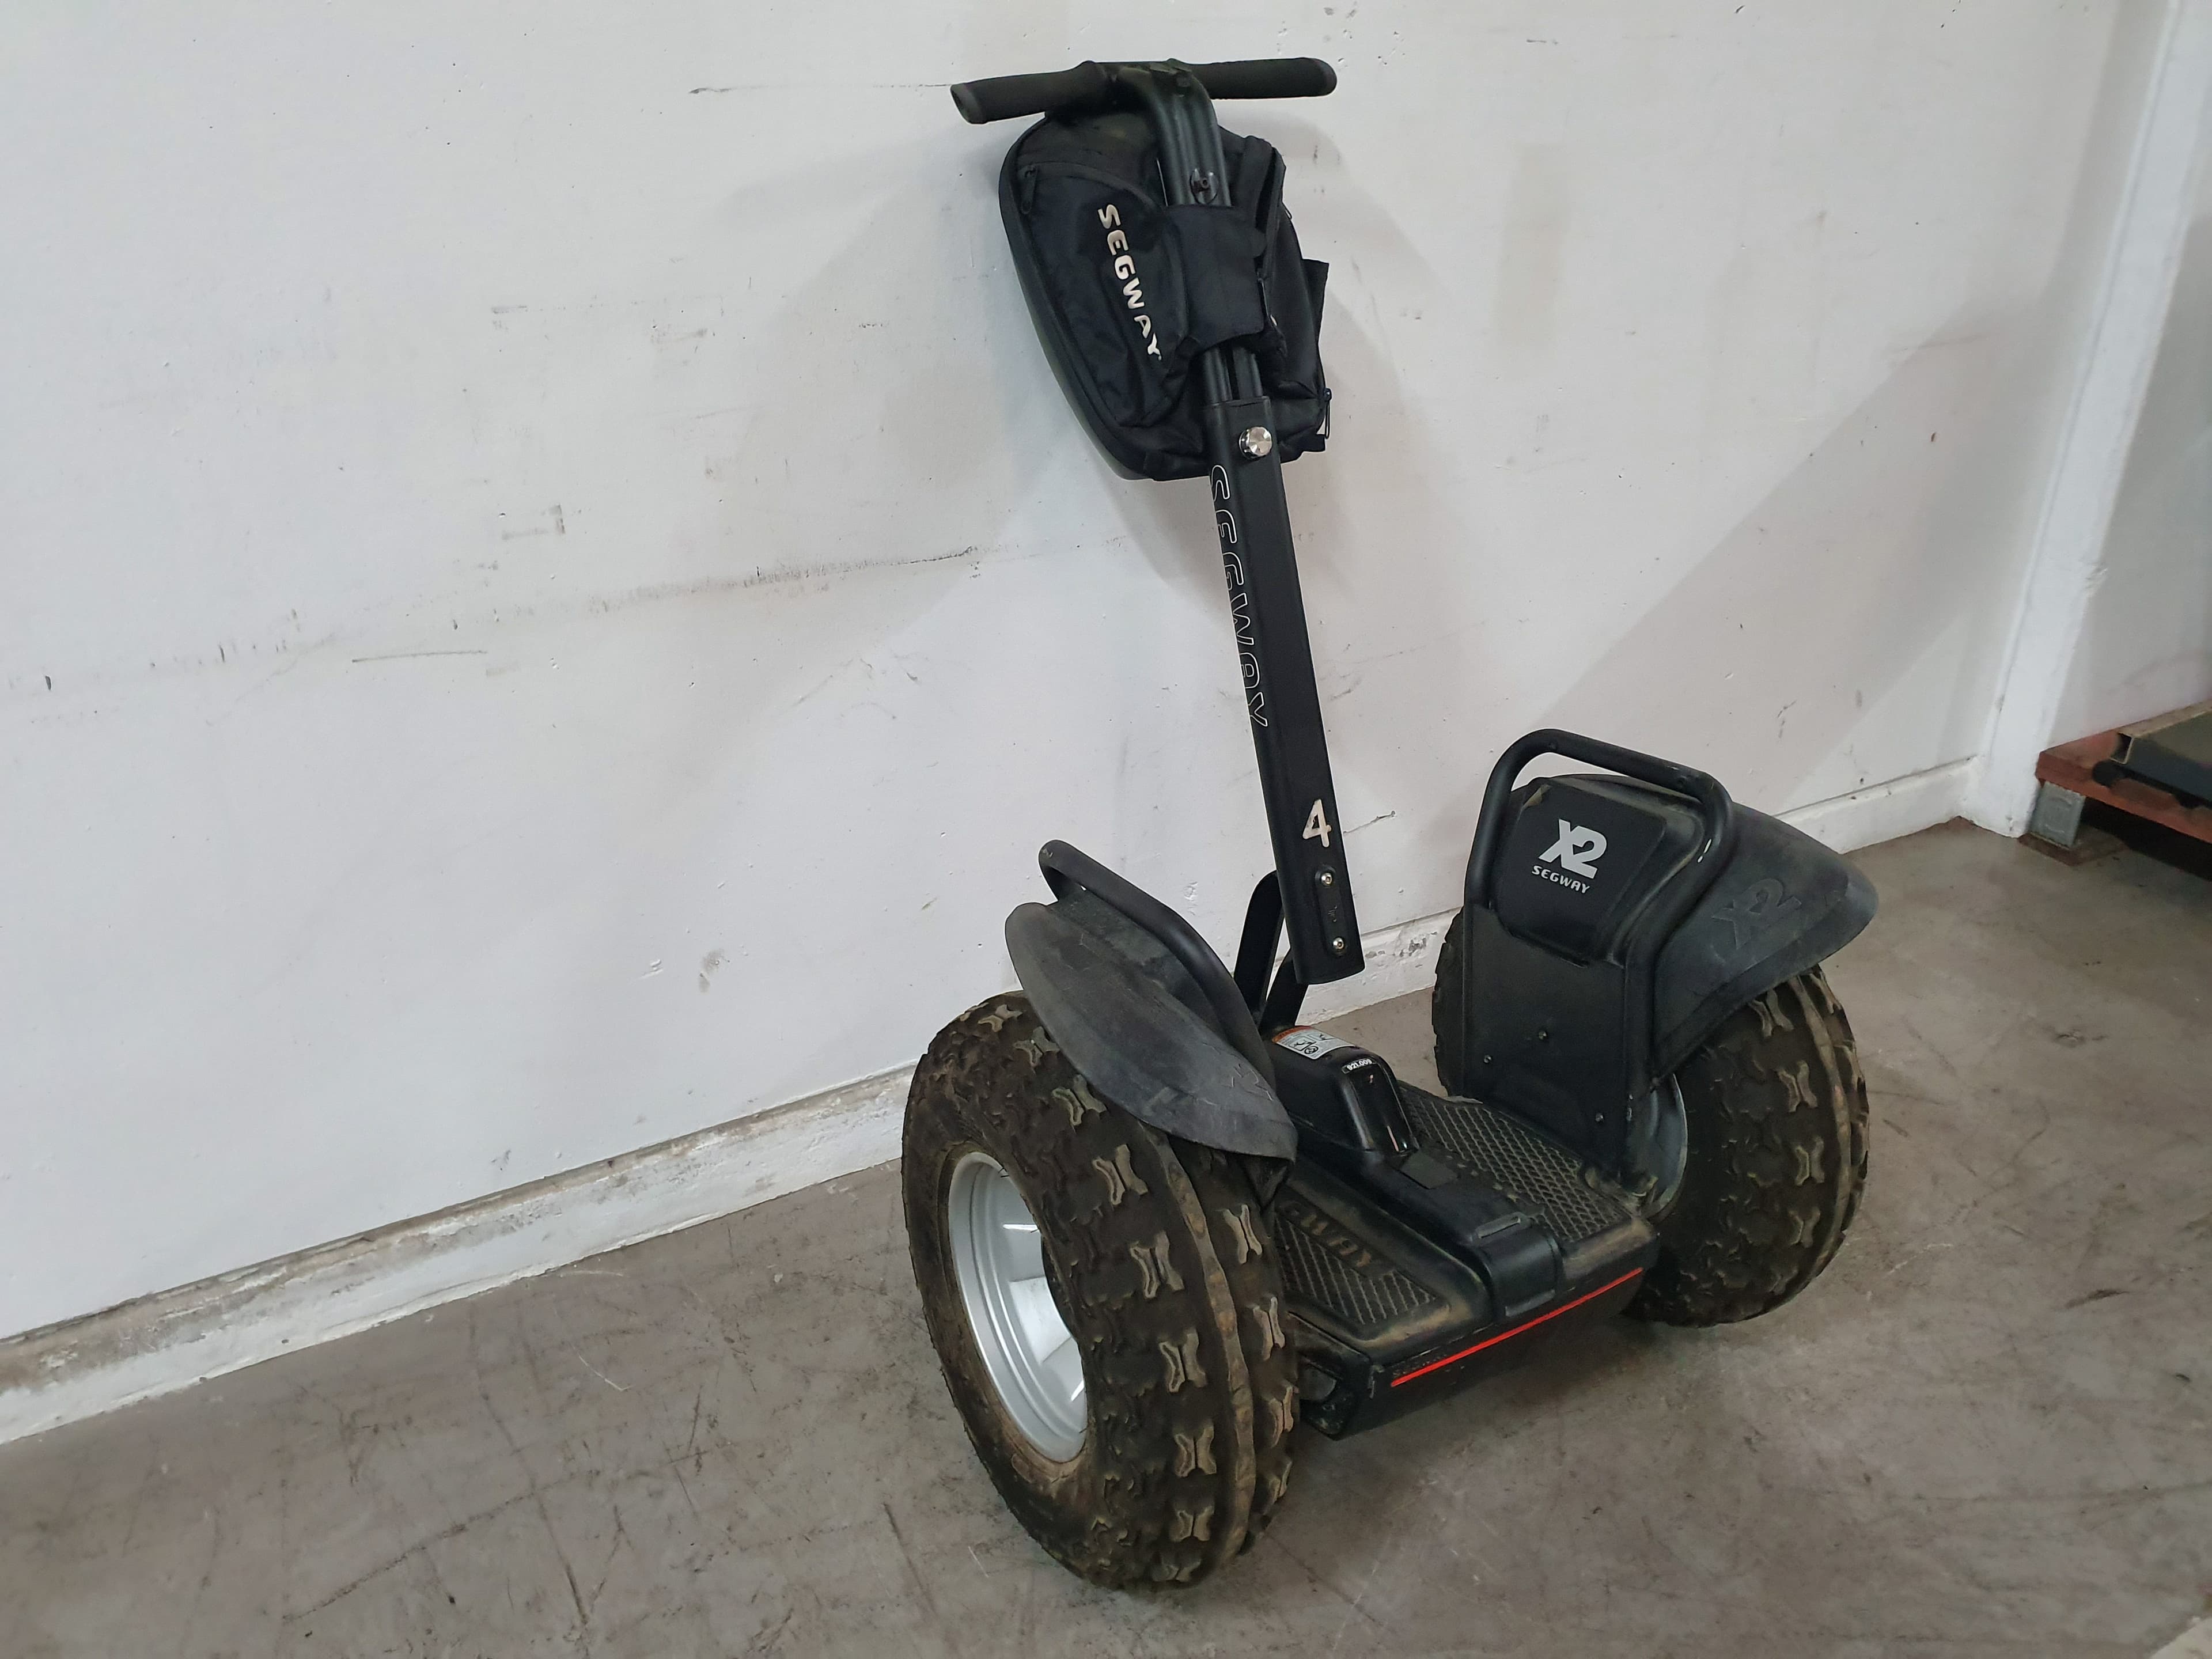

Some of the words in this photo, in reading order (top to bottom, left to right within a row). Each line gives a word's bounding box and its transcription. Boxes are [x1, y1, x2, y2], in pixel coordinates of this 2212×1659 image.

[1097, 204, 1161, 356] SEGWAY
[1302, 798, 1332, 847] 4
[1538, 819, 1607, 879] X2
[1531, 865, 1590, 893] SEGWAY
